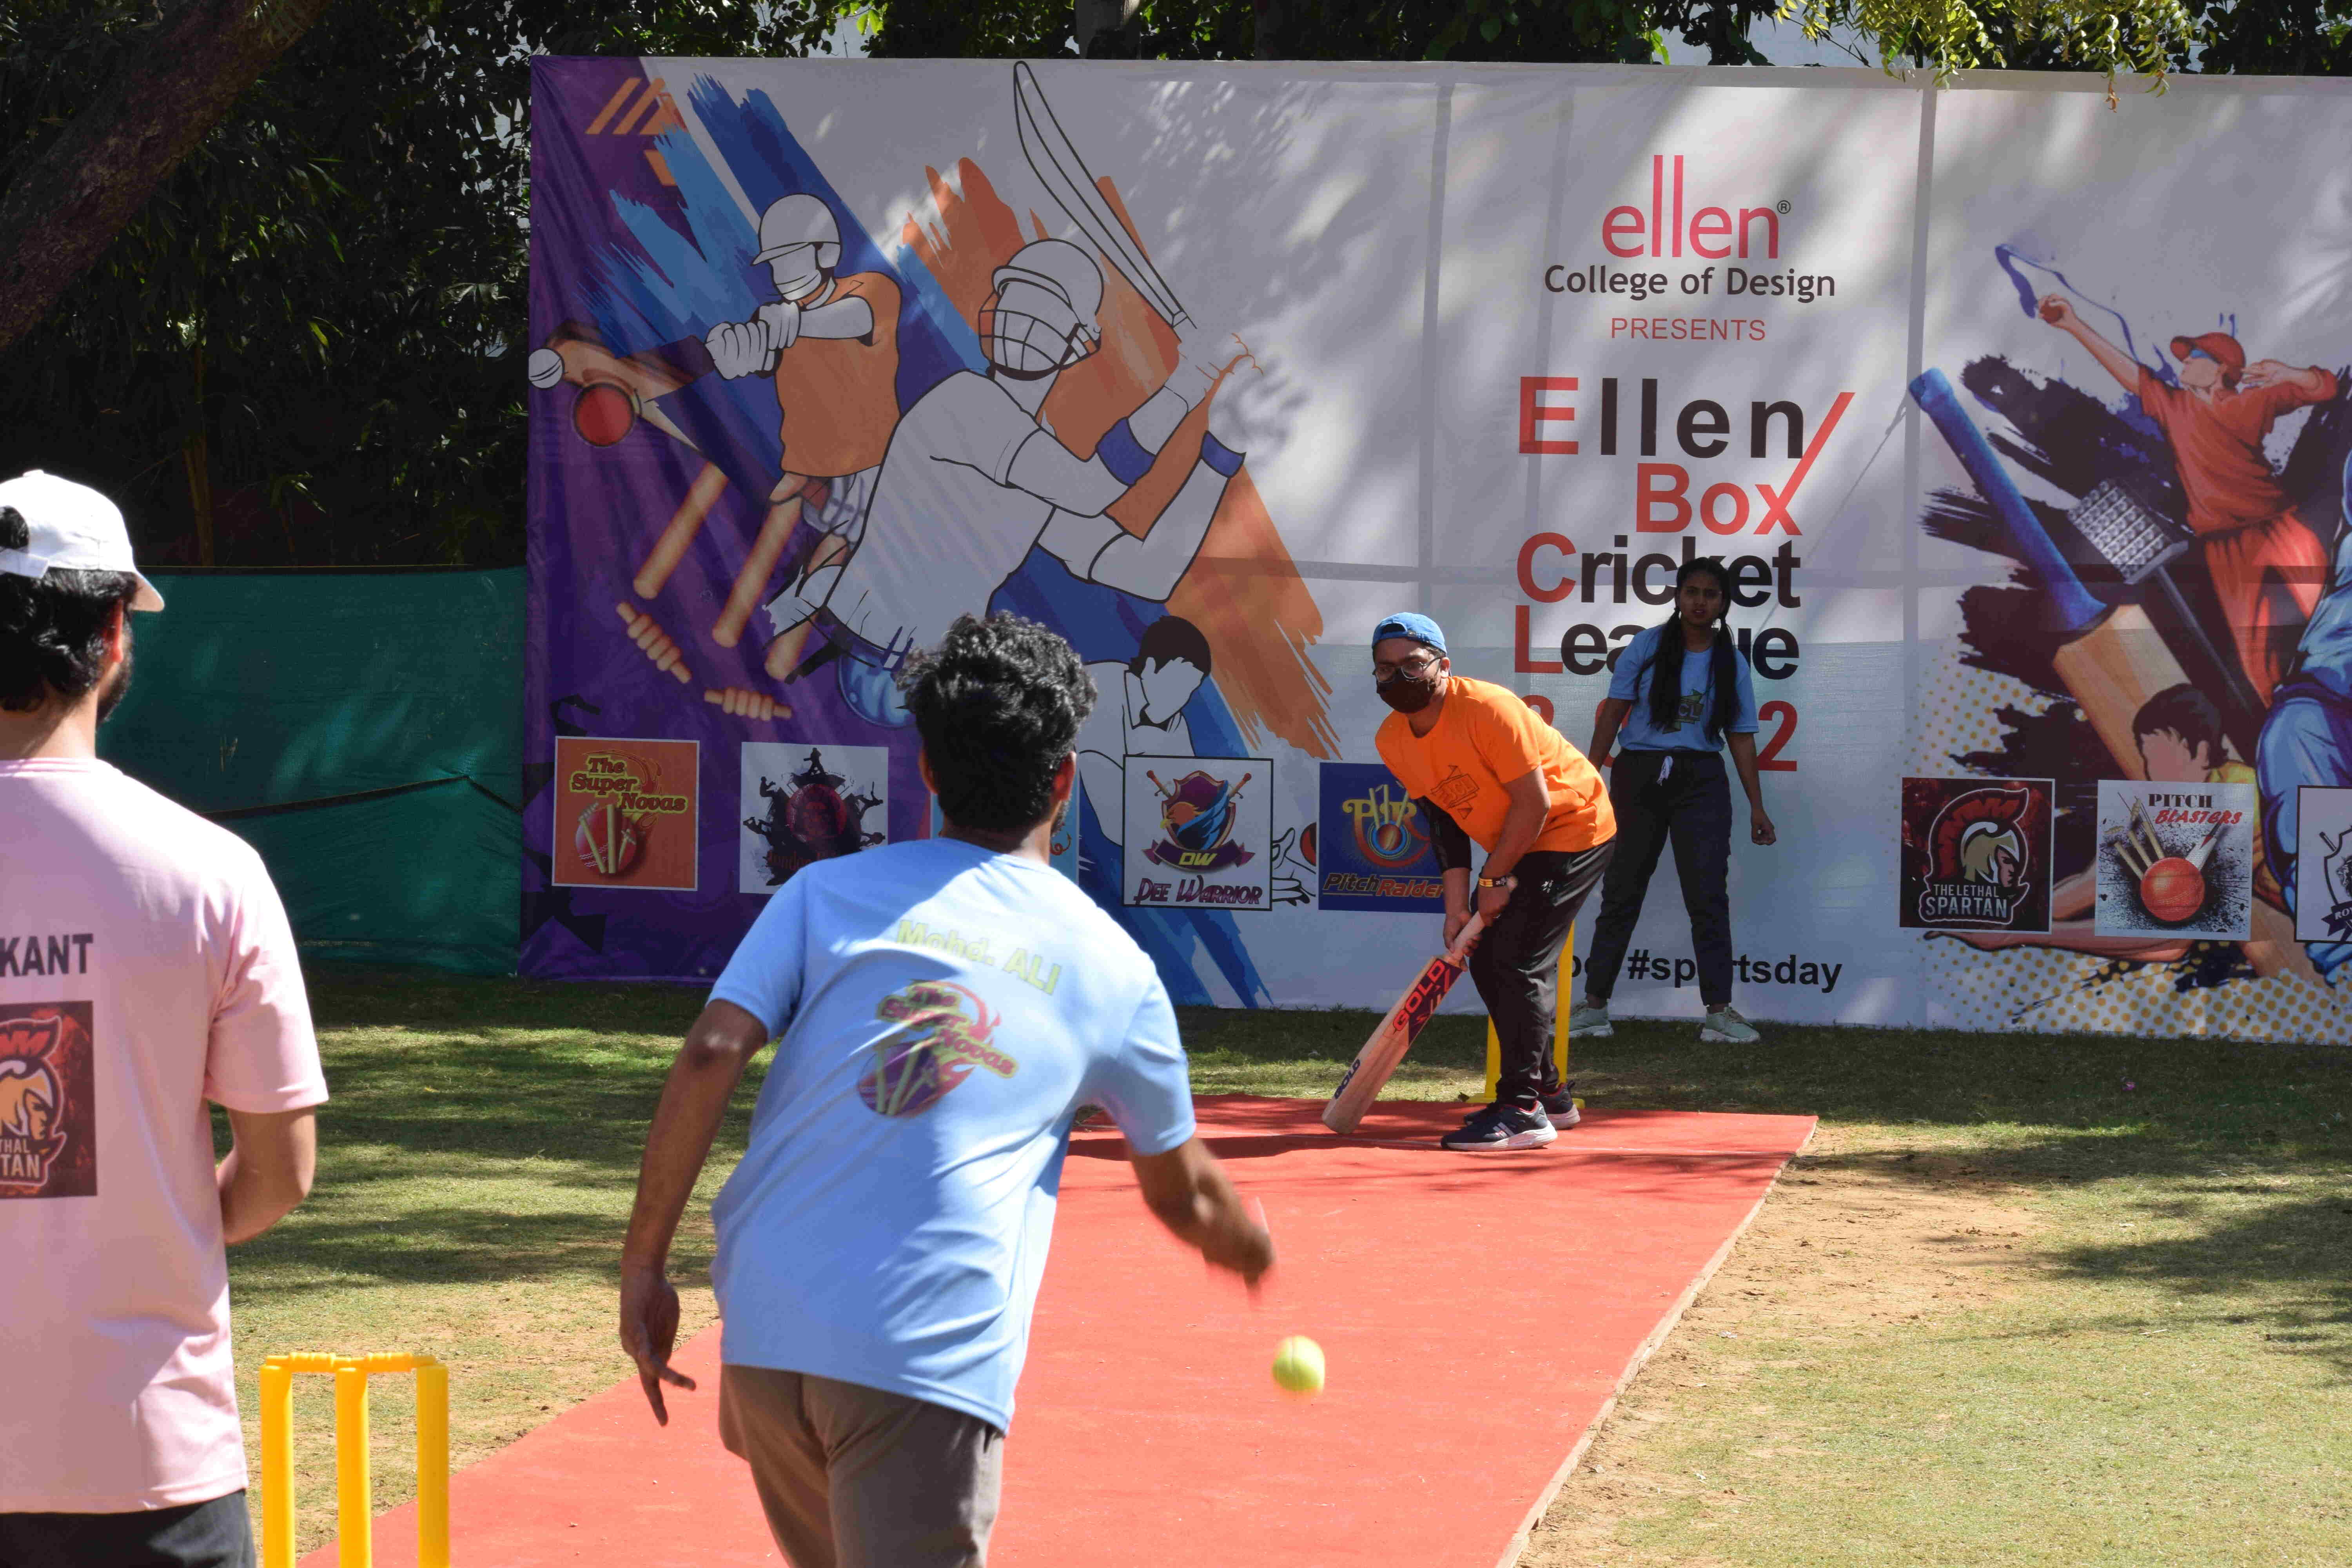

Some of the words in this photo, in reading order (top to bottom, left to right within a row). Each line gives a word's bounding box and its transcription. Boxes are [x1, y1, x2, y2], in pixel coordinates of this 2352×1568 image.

[1544, 265, 1668, 301] College
[1680, 267, 1715, 295] of
[1727, 268, 1835, 303] Design
[1611, 318, 1766, 341] PRESENTS
[1519, 376, 1804, 459] Ellen
[587, 756, 626, 775] The
[571, 773, 638, 795] Super
[620, 793, 686, 811] Novas
[2148, 793, 2213, 808] PITCH
[2155, 809, 2243, 824] BLASTERS
[1933, 884, 1955, 896] THE
[1956, 885, 1999, 897] LETHAL
[1926, 897, 2007, 918] SPARTAN
[2334, 907, 2352, 920] RO
[1002, 947, 1062, 996] ALI
[1628, 949, 1842, 993] #sptsday
[1392, 959, 1445, 1032] GOLD
